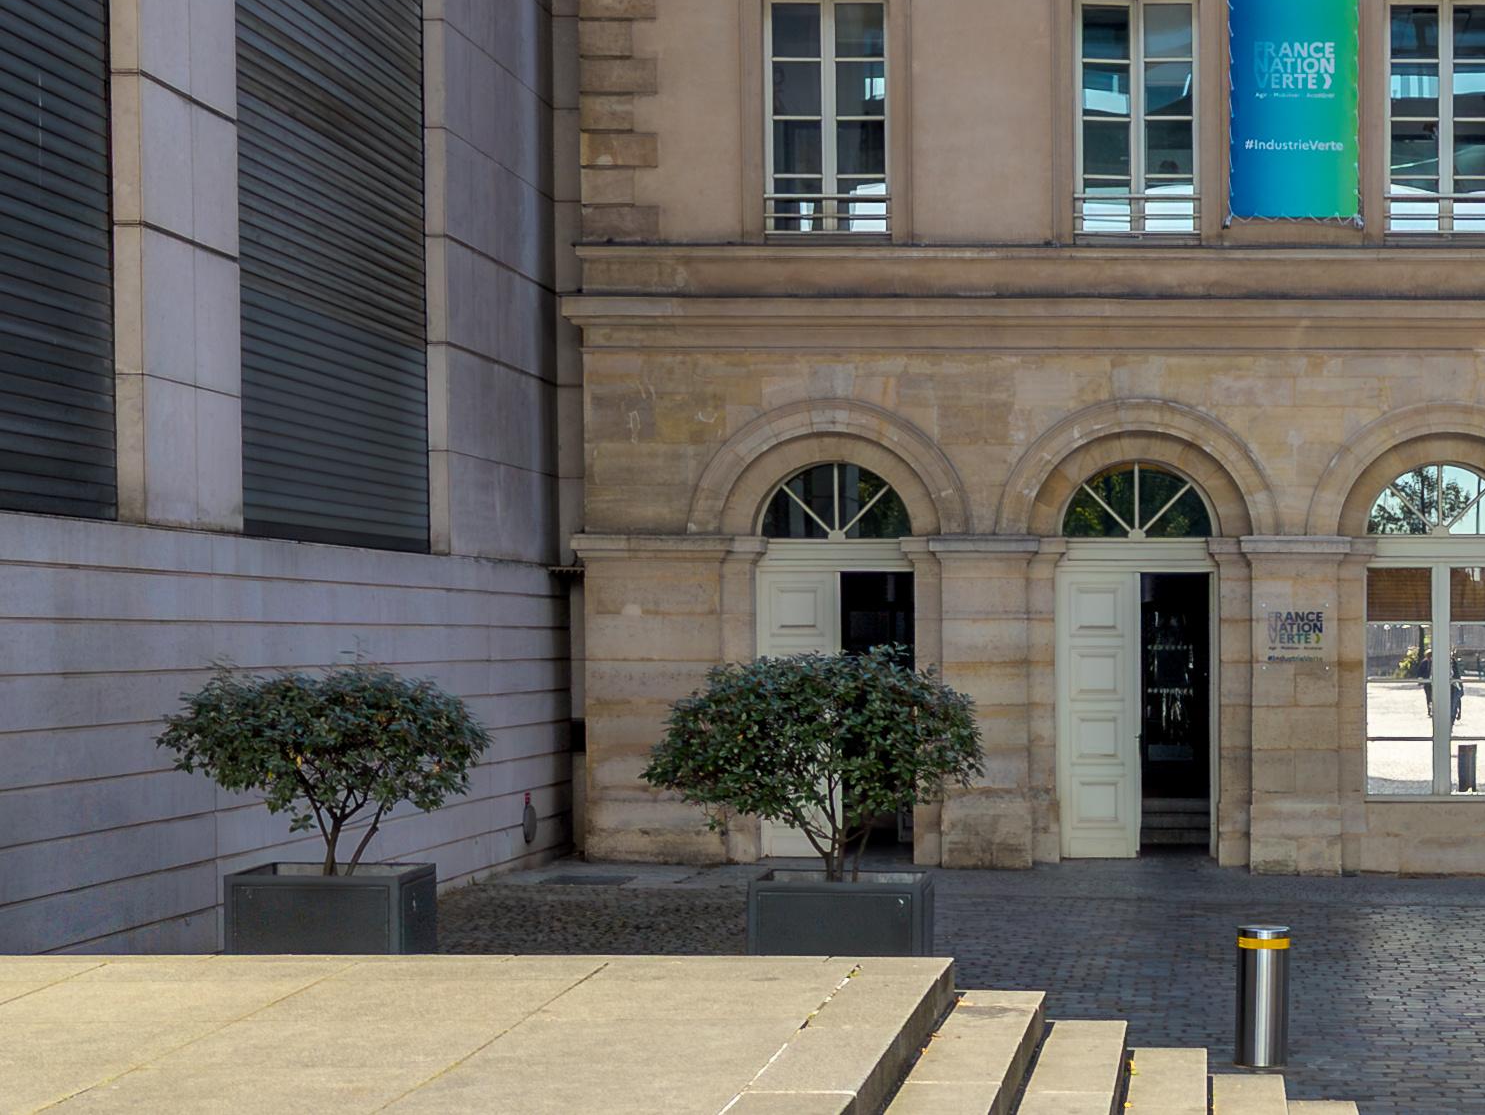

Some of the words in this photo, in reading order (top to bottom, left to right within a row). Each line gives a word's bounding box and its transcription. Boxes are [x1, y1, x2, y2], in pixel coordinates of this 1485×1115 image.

[1254, 42, 1335, 58] FRANCE
[1254, 58, 1335, 73] NATION
[1255, 73, 1318, 89] VERTE
[1245, 139, 1344, 150] #IndustrieVerte
[1267, 611, 1323, 622] FRANCE
[1267, 622, 1323, 633] NATION
[1268, 633, 1311, 644] VERTE
